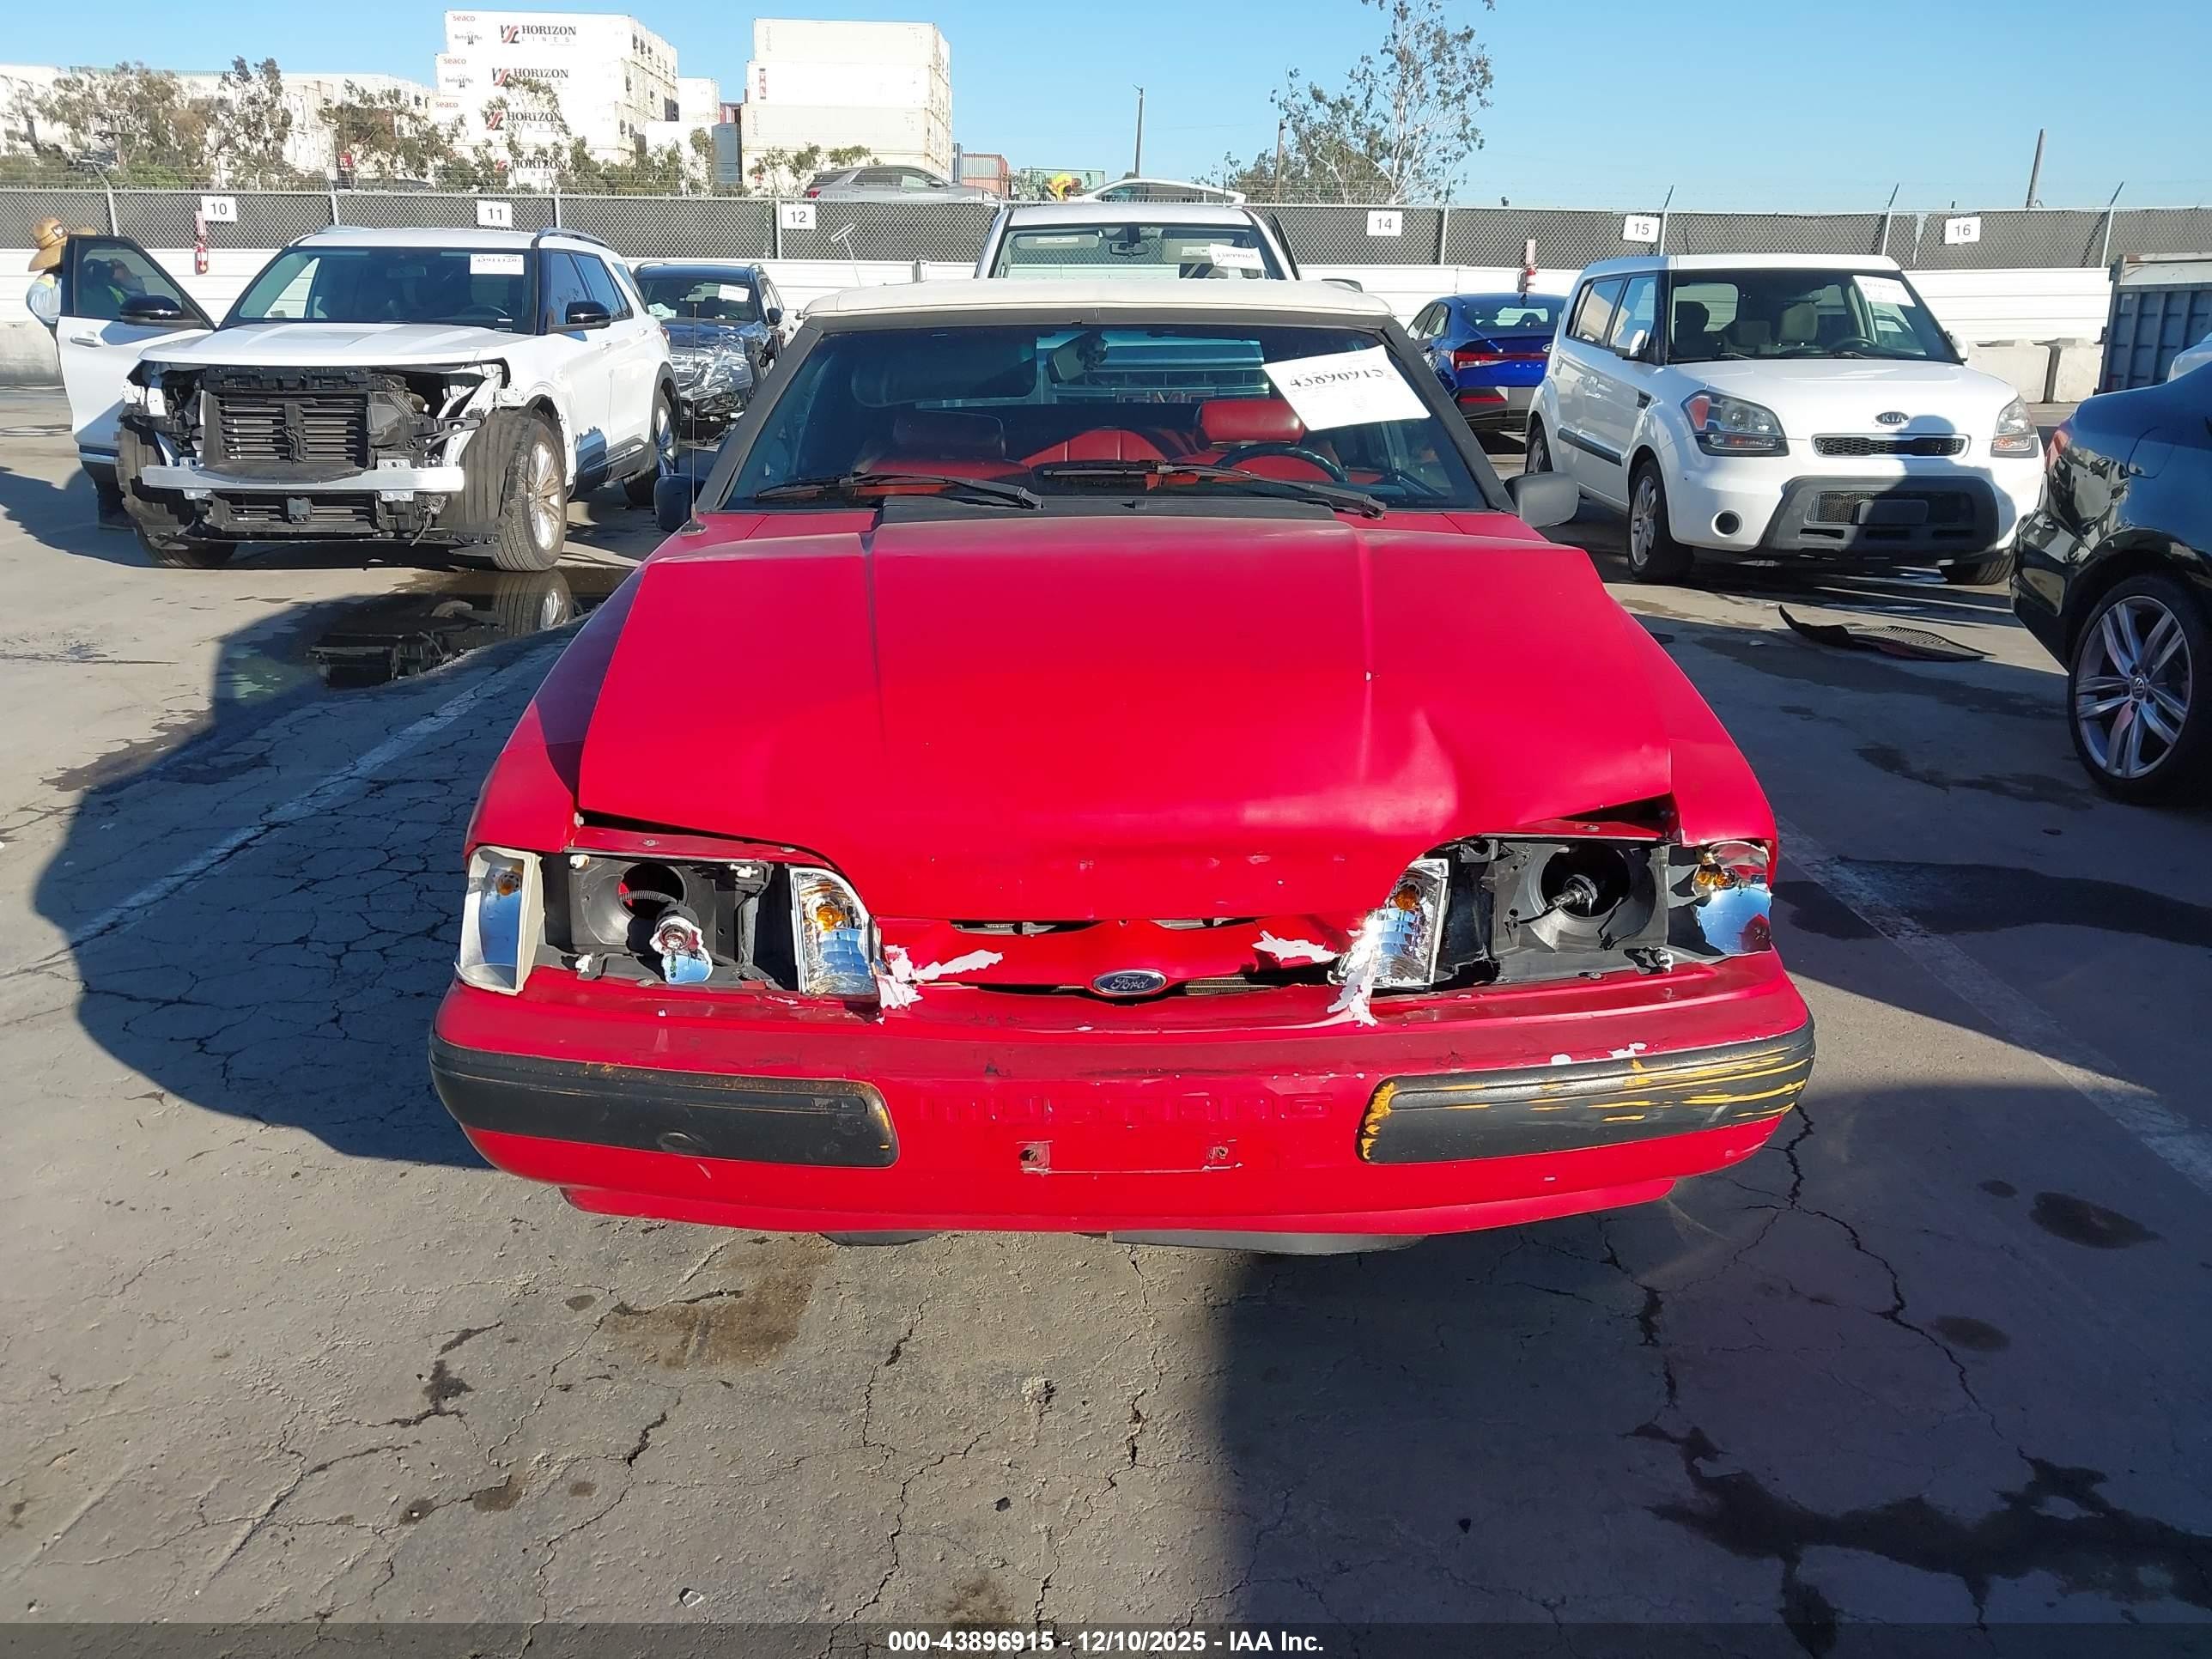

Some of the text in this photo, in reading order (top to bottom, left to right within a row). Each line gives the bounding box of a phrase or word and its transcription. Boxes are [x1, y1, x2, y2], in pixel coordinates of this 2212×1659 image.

[521, 25, 577, 36] HORIZON
[514, 68, 569, 78] HORIZON
[507, 112, 563, 122] HORIZON
[210, 203, 228, 215] 10
[488, 208, 501, 220] 11
[790, 211, 807, 222] 12
[1376, 218, 1392, 229] 14
[1634, 223, 1650, 234] 15
[1954, 224, 1971, 236] 16
[1881, 413, 1904, 422] KIA
[1110, 975, 1150, 990] Ford
